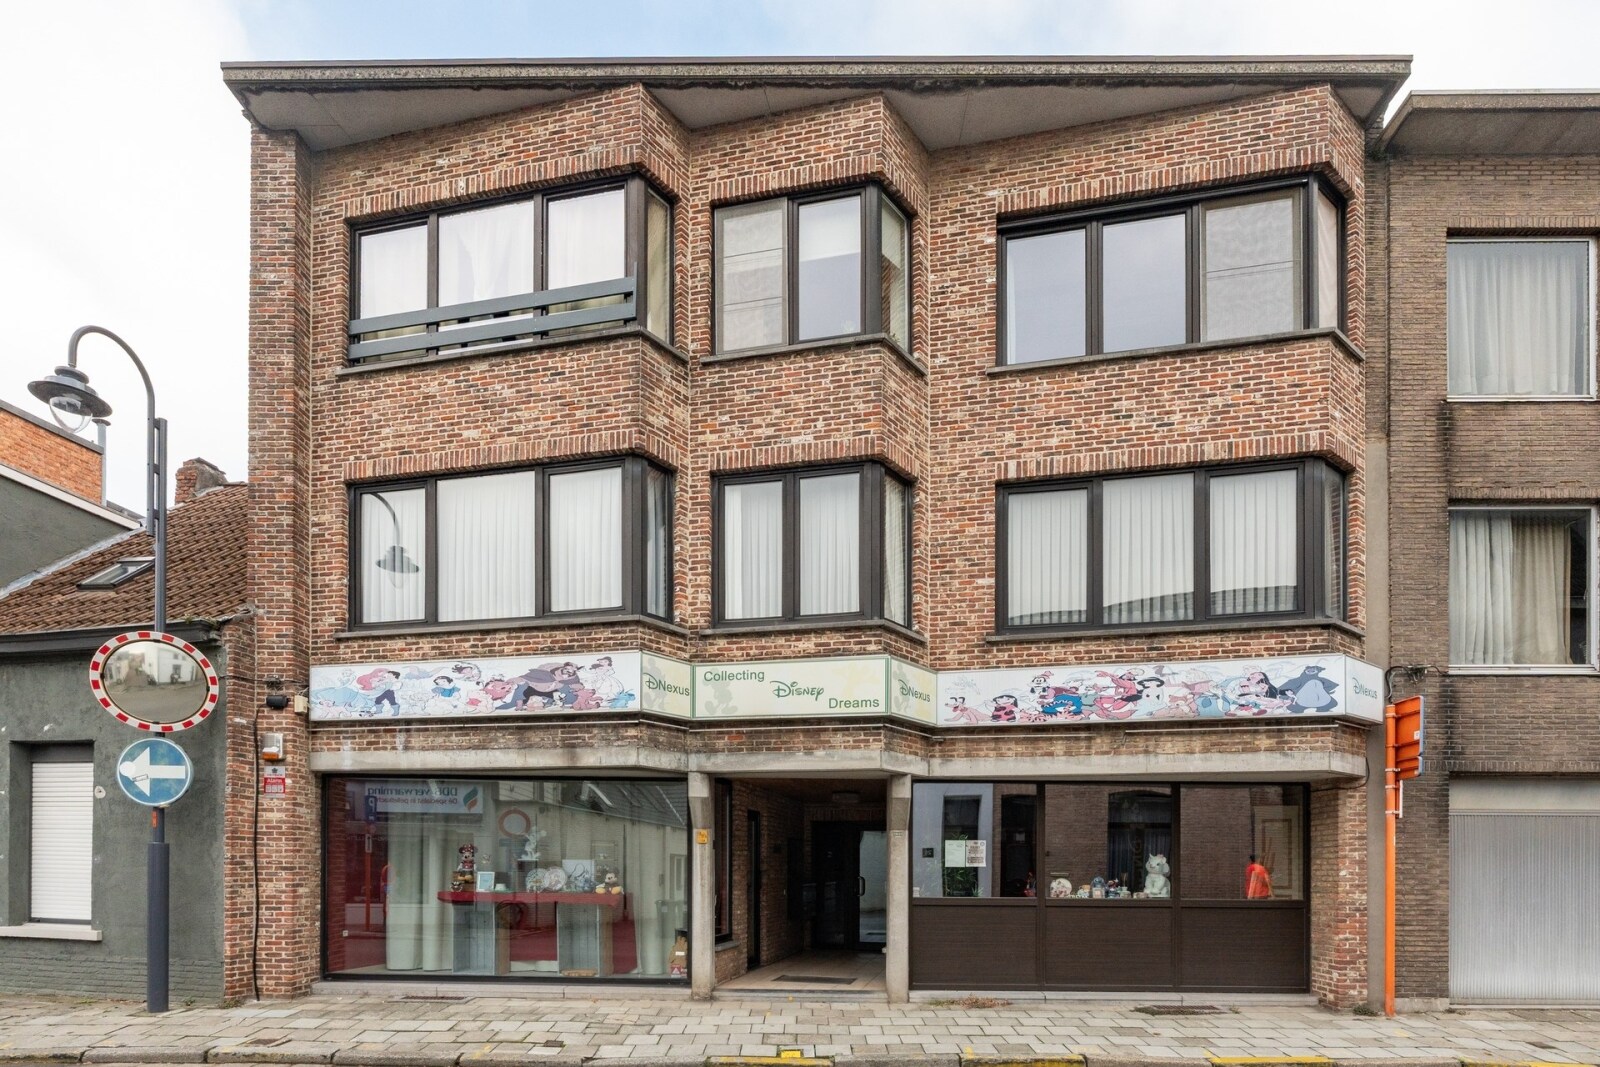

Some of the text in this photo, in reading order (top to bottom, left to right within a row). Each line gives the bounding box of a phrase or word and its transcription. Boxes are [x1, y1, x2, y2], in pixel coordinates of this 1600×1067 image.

[703, 670, 765, 682] Collecting
[769, 681, 824, 701] Disney
[828, 698, 880, 709] Dreams
